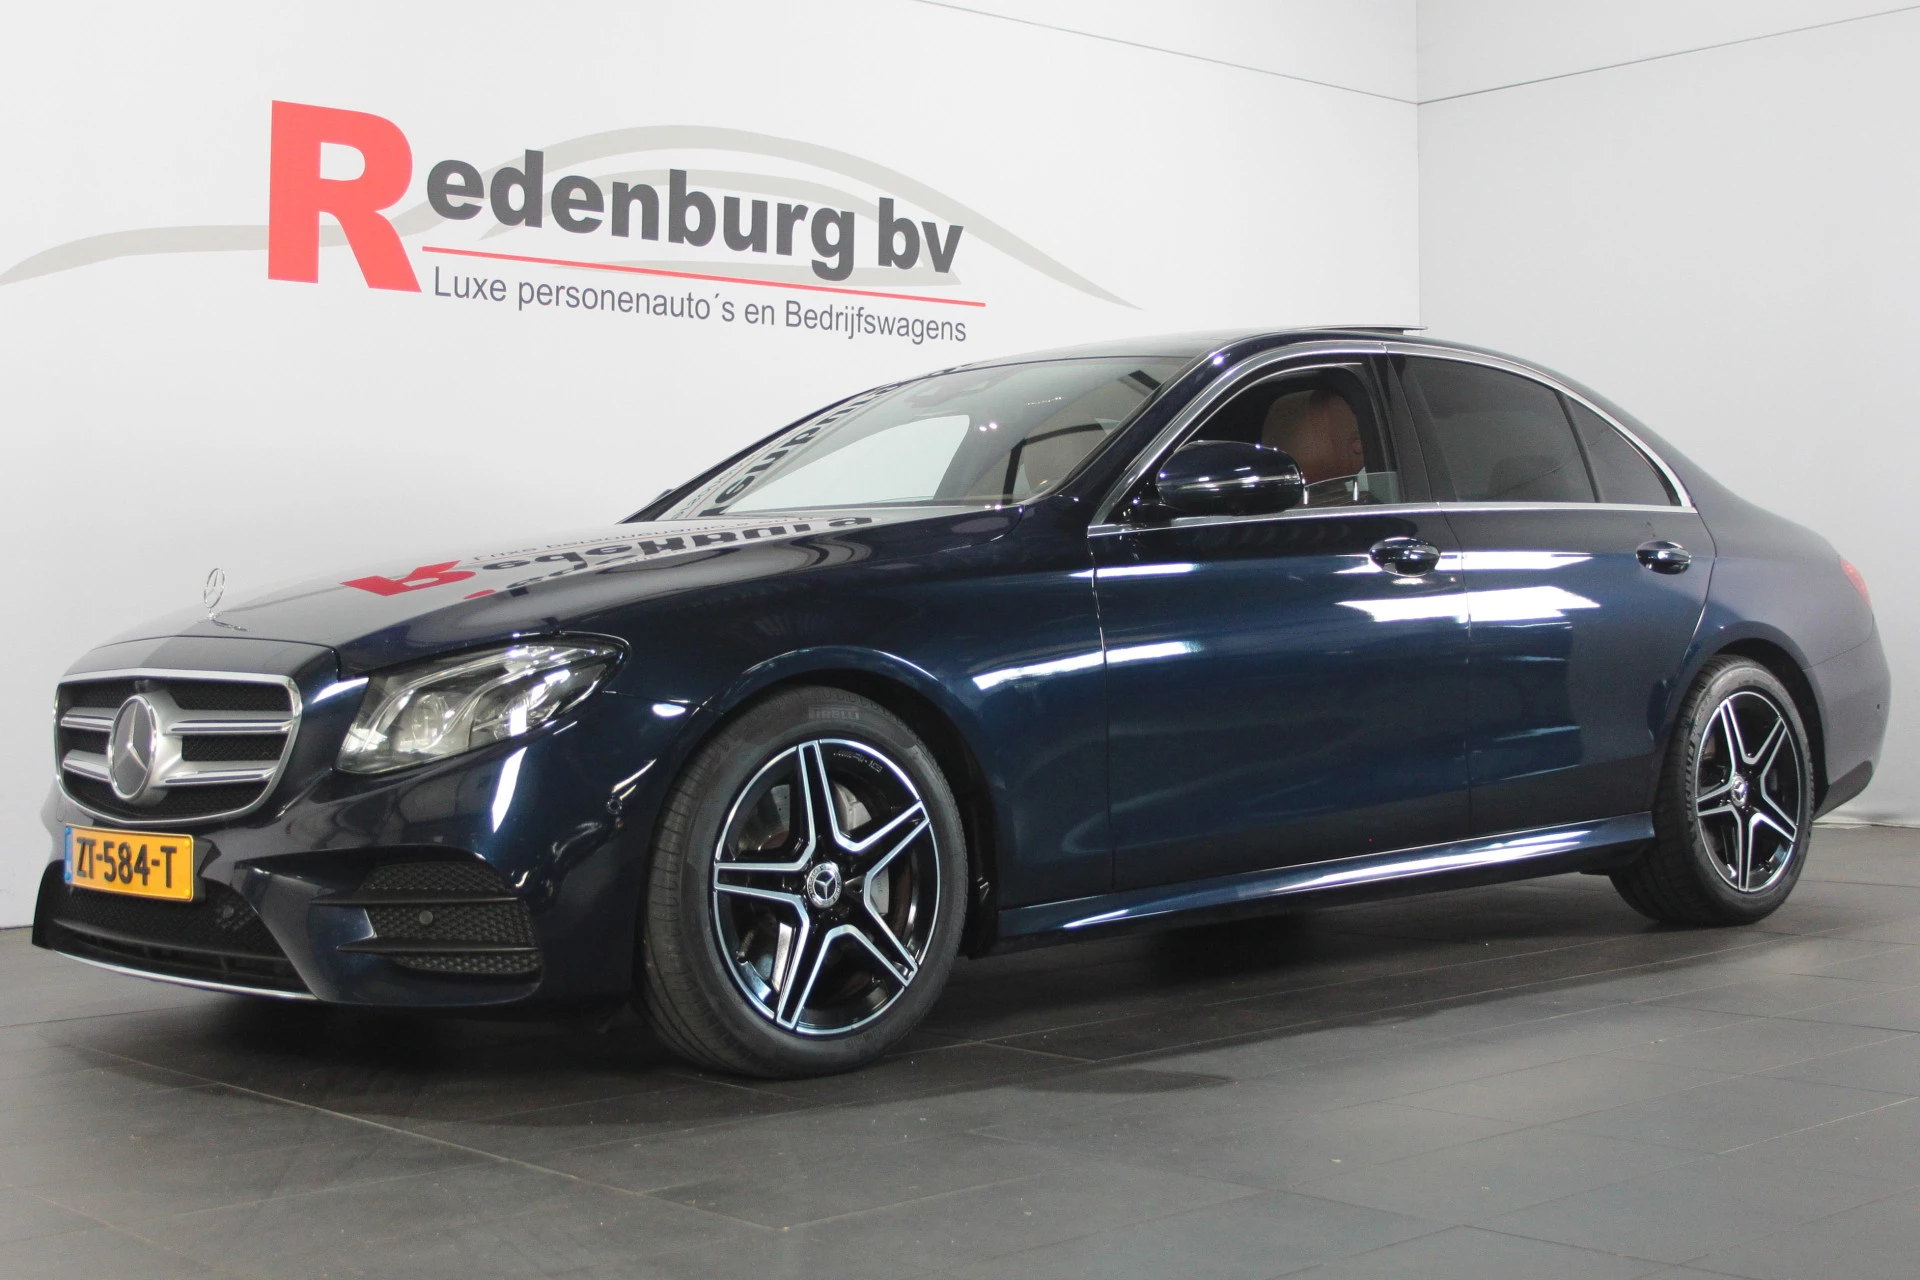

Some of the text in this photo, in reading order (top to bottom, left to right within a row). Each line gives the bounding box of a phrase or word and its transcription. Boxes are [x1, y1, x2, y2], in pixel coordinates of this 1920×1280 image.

[268, 100, 964, 293] Redenburg bv
[434, 265, 507, 302] Luxe
[744, 303, 775, 326] en
[785, 300, 967, 345] Bedrijfswagens
[76, 837, 177, 888] ZT-584-T
